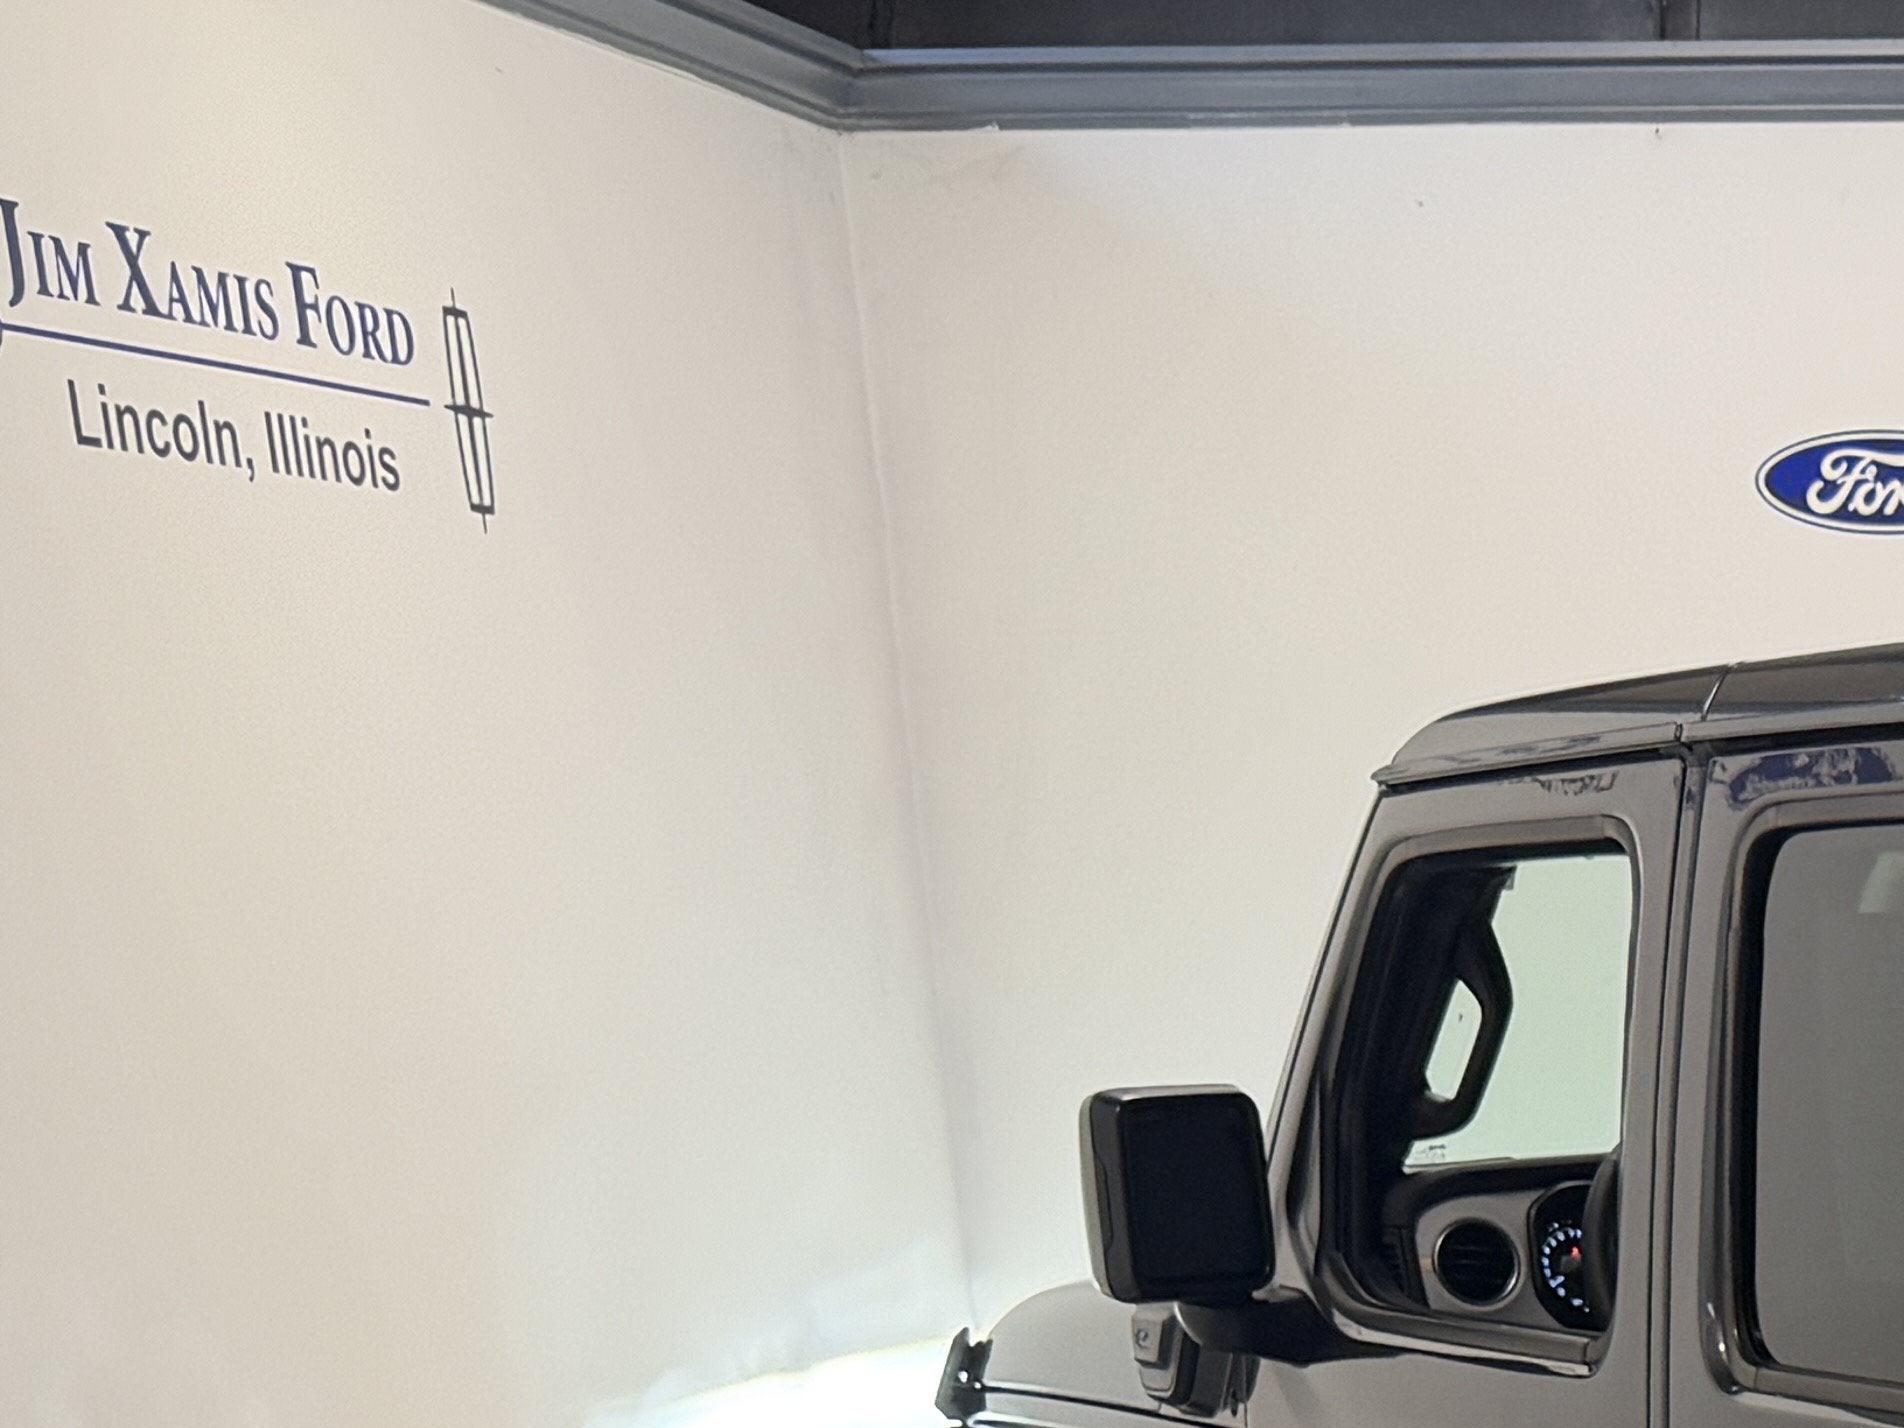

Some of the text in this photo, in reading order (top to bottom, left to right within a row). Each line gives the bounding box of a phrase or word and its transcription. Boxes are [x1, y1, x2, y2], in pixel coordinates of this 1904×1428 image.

[0, 198, 415, 366] JIM XAMIS FORD
[67, 379, 401, 492] Lincoln, Illinois
